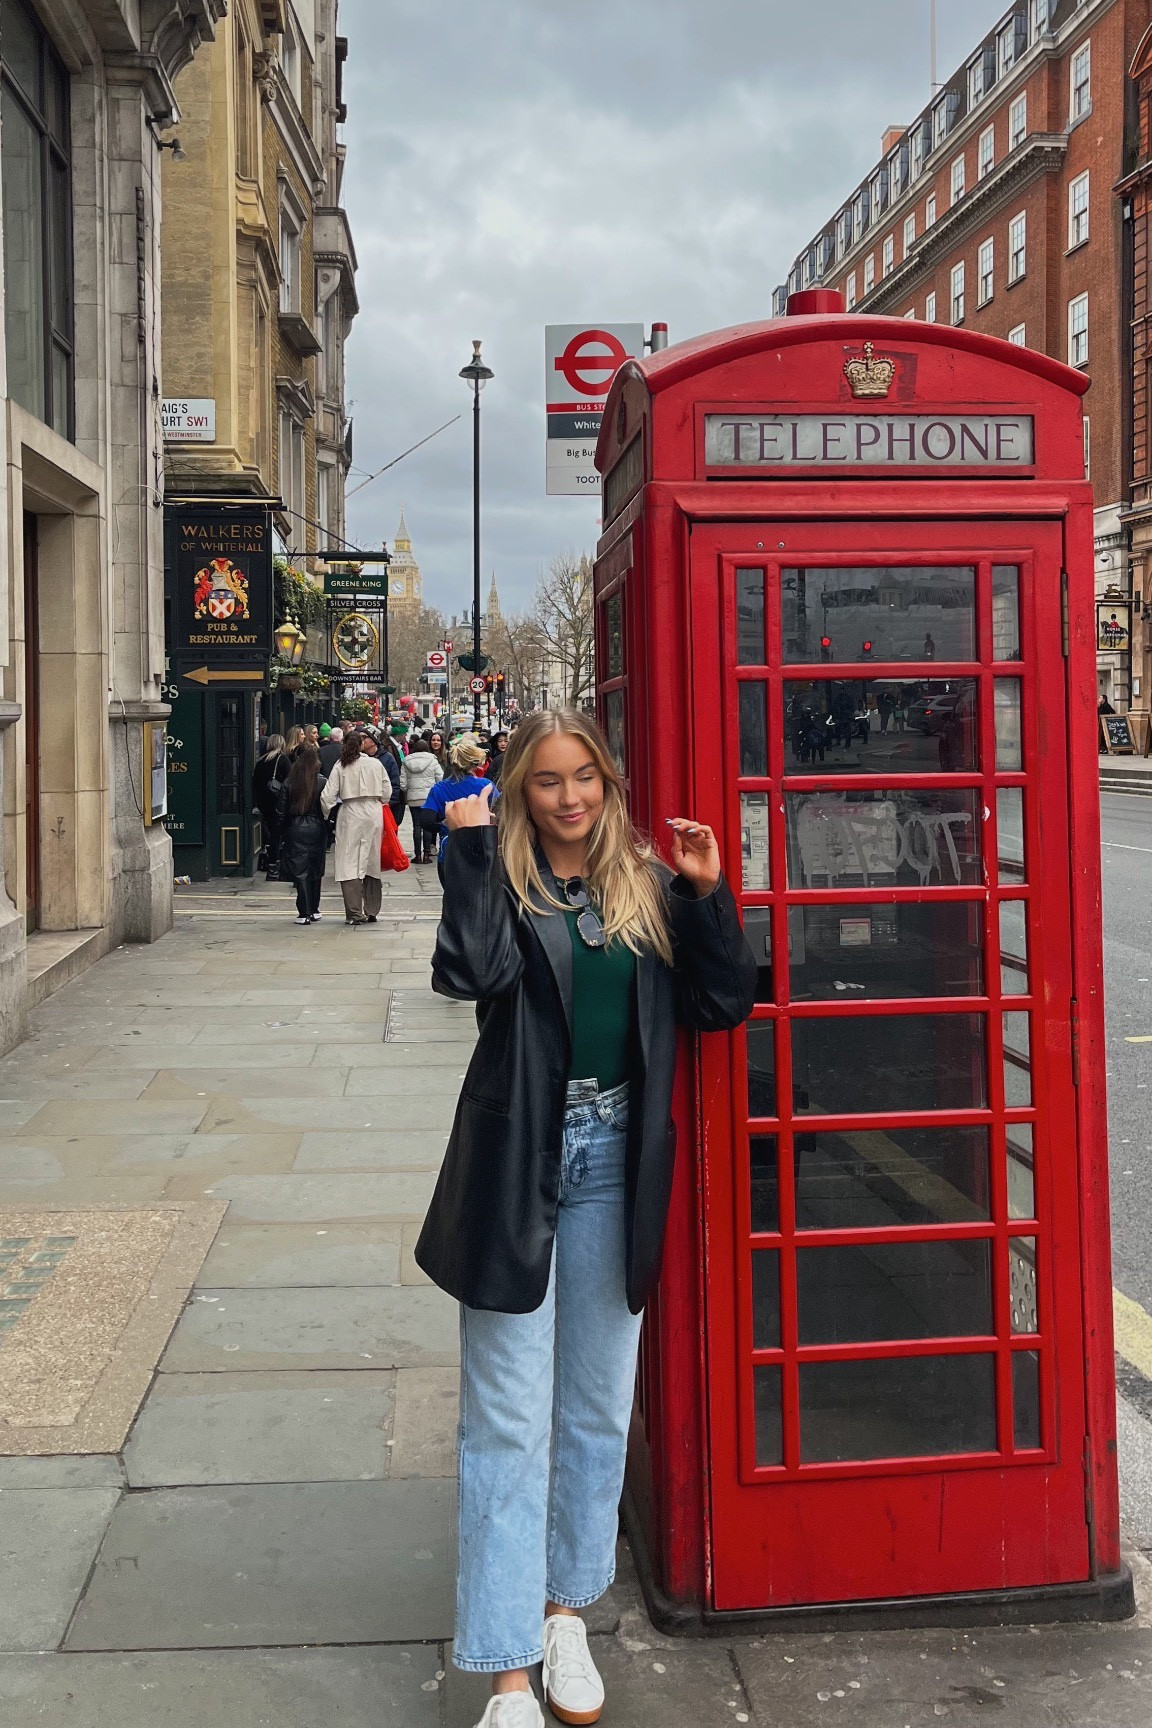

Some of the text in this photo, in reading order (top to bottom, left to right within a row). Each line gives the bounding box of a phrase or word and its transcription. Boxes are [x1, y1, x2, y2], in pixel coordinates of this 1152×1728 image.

[162, 416, 208, 427] URT SW1
[574, 421, 601, 429] White
[719, 422, 1020, 461] TELEPHONE
[566, 449, 580, 458] Big
[181, 524, 264, 539] WALKERS
[180, 542, 264, 552] OF WHITEHALL
[207, 623, 238, 632] PUB &
[188, 635, 258, 644] RESTAURANT
[444, 642, 453, 650] M
[472, 681, 484, 689] 20
